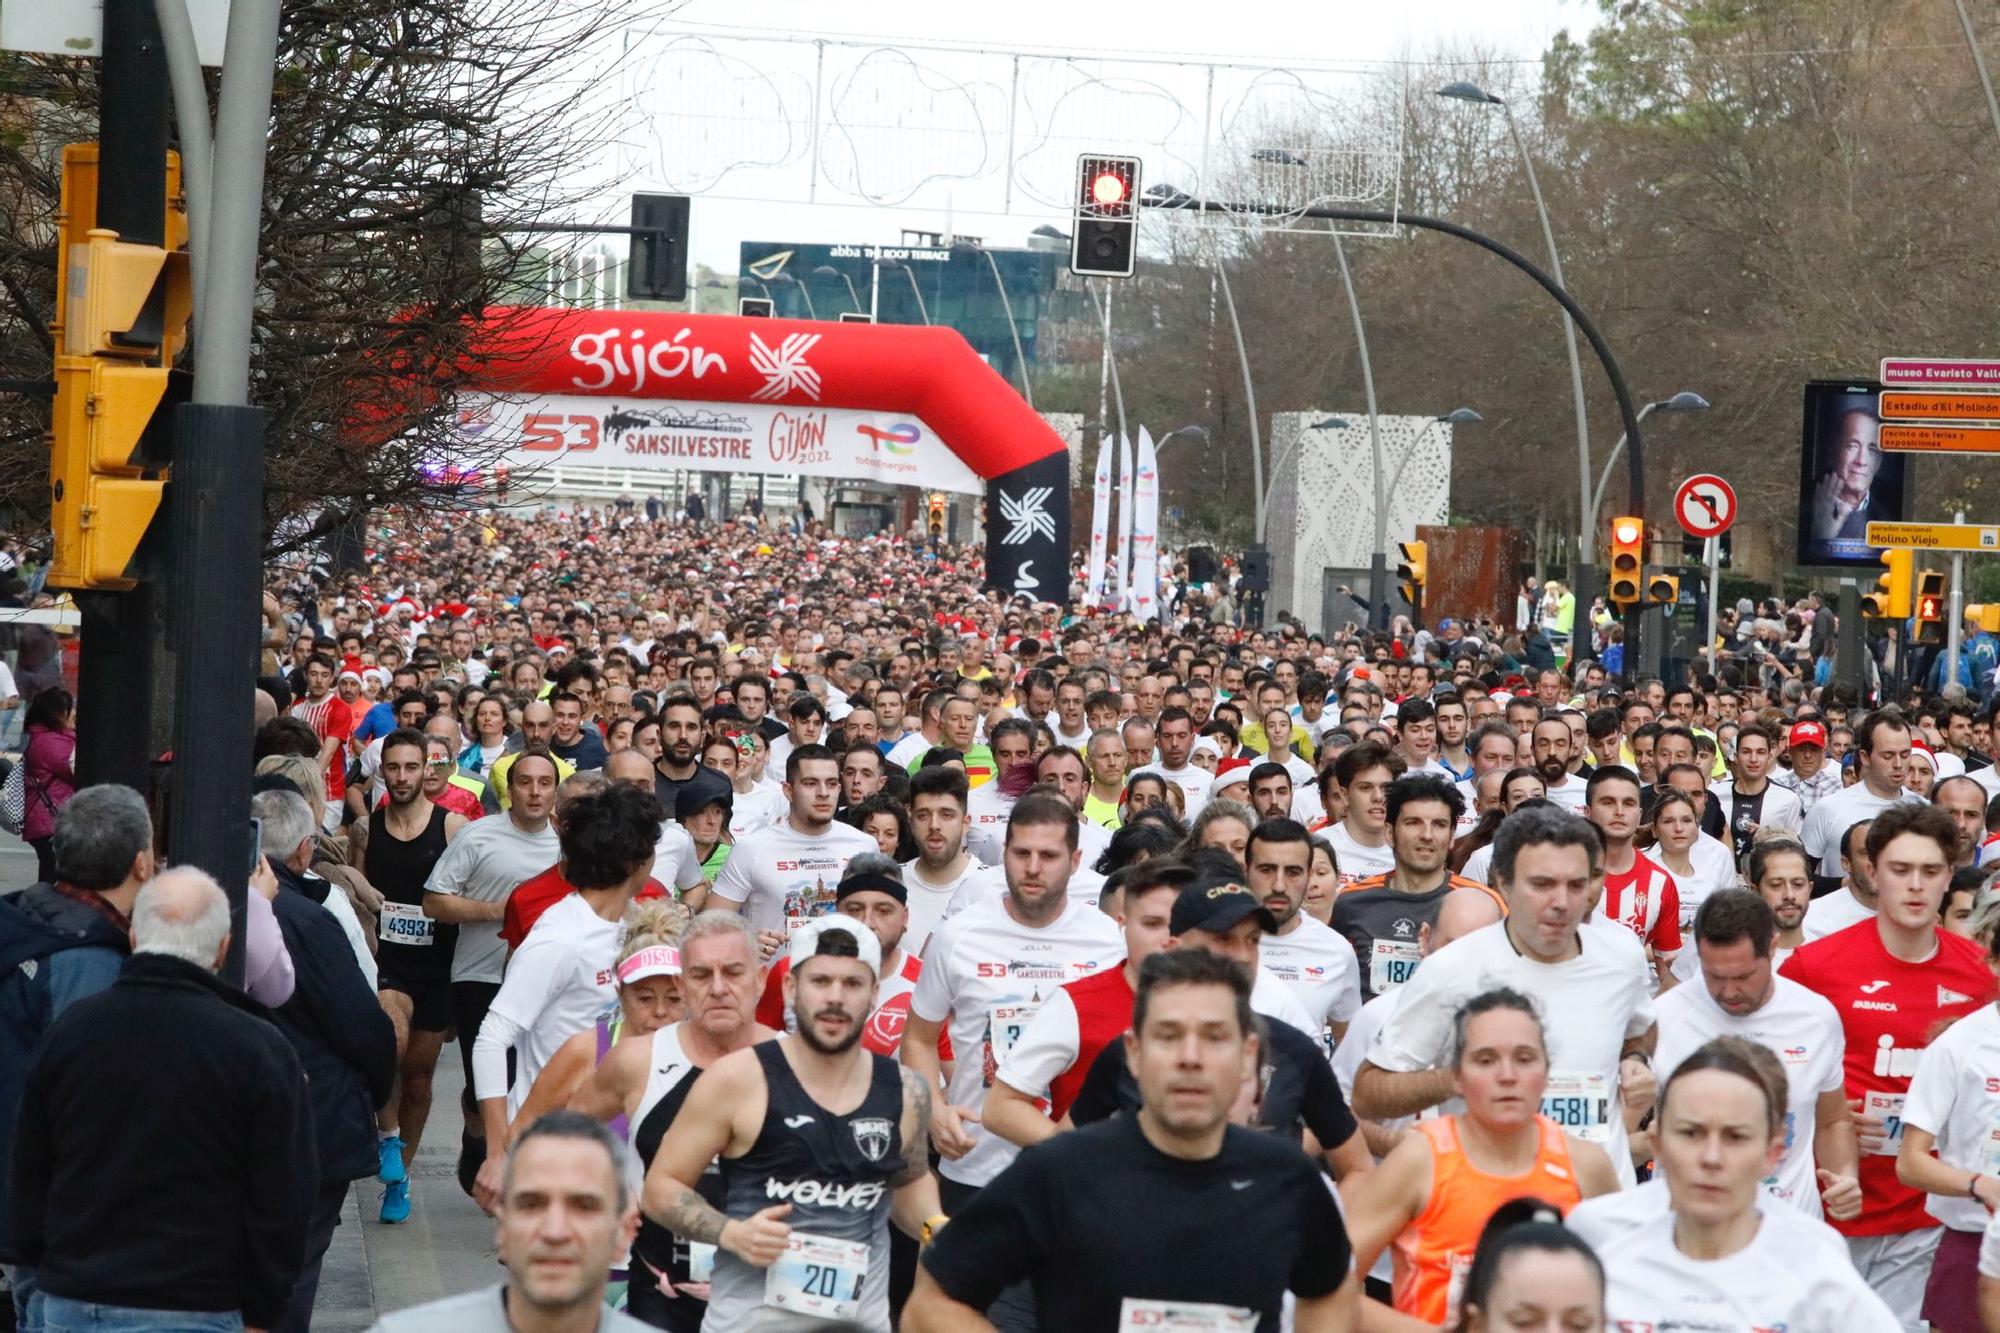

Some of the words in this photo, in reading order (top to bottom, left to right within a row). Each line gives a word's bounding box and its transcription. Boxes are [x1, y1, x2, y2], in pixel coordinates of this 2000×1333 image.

[830, 245, 860, 257] abba
[883, 249, 910, 259] ROOF
[911, 250, 950, 261] TERRACE
[570, 327, 727, 392] gijón
[1887, 368, 1923, 378] museo
[1926, 368, 1973, 378] Evaristo
[1886, 402, 1928, 411] Estadiu
[1931, 403, 1952, 412] d'El
[1955, 403, 1998, 413] Molinón
[521, 415, 599, 451] 53
[1932, 431, 1957, 439] ferias
[624, 434, 752, 459] SANSILVESTRE
[799, 450, 832, 464] 2022
[1871, 534, 1908, 544] Molino
[1911, 535, 1939, 547] Viejo
[777, 861, 798, 871] 53
[388, 917, 426, 936] 4393
[1377, 945, 1395, 954] 53
[976, 963, 1007, 977] 53
[1853, 1000, 1898, 1012] ABANCA
[1871, 1098, 1892, 1108] 53
[765, 1177, 887, 1211] WOLVES
[803, 1264, 838, 1298] 20
